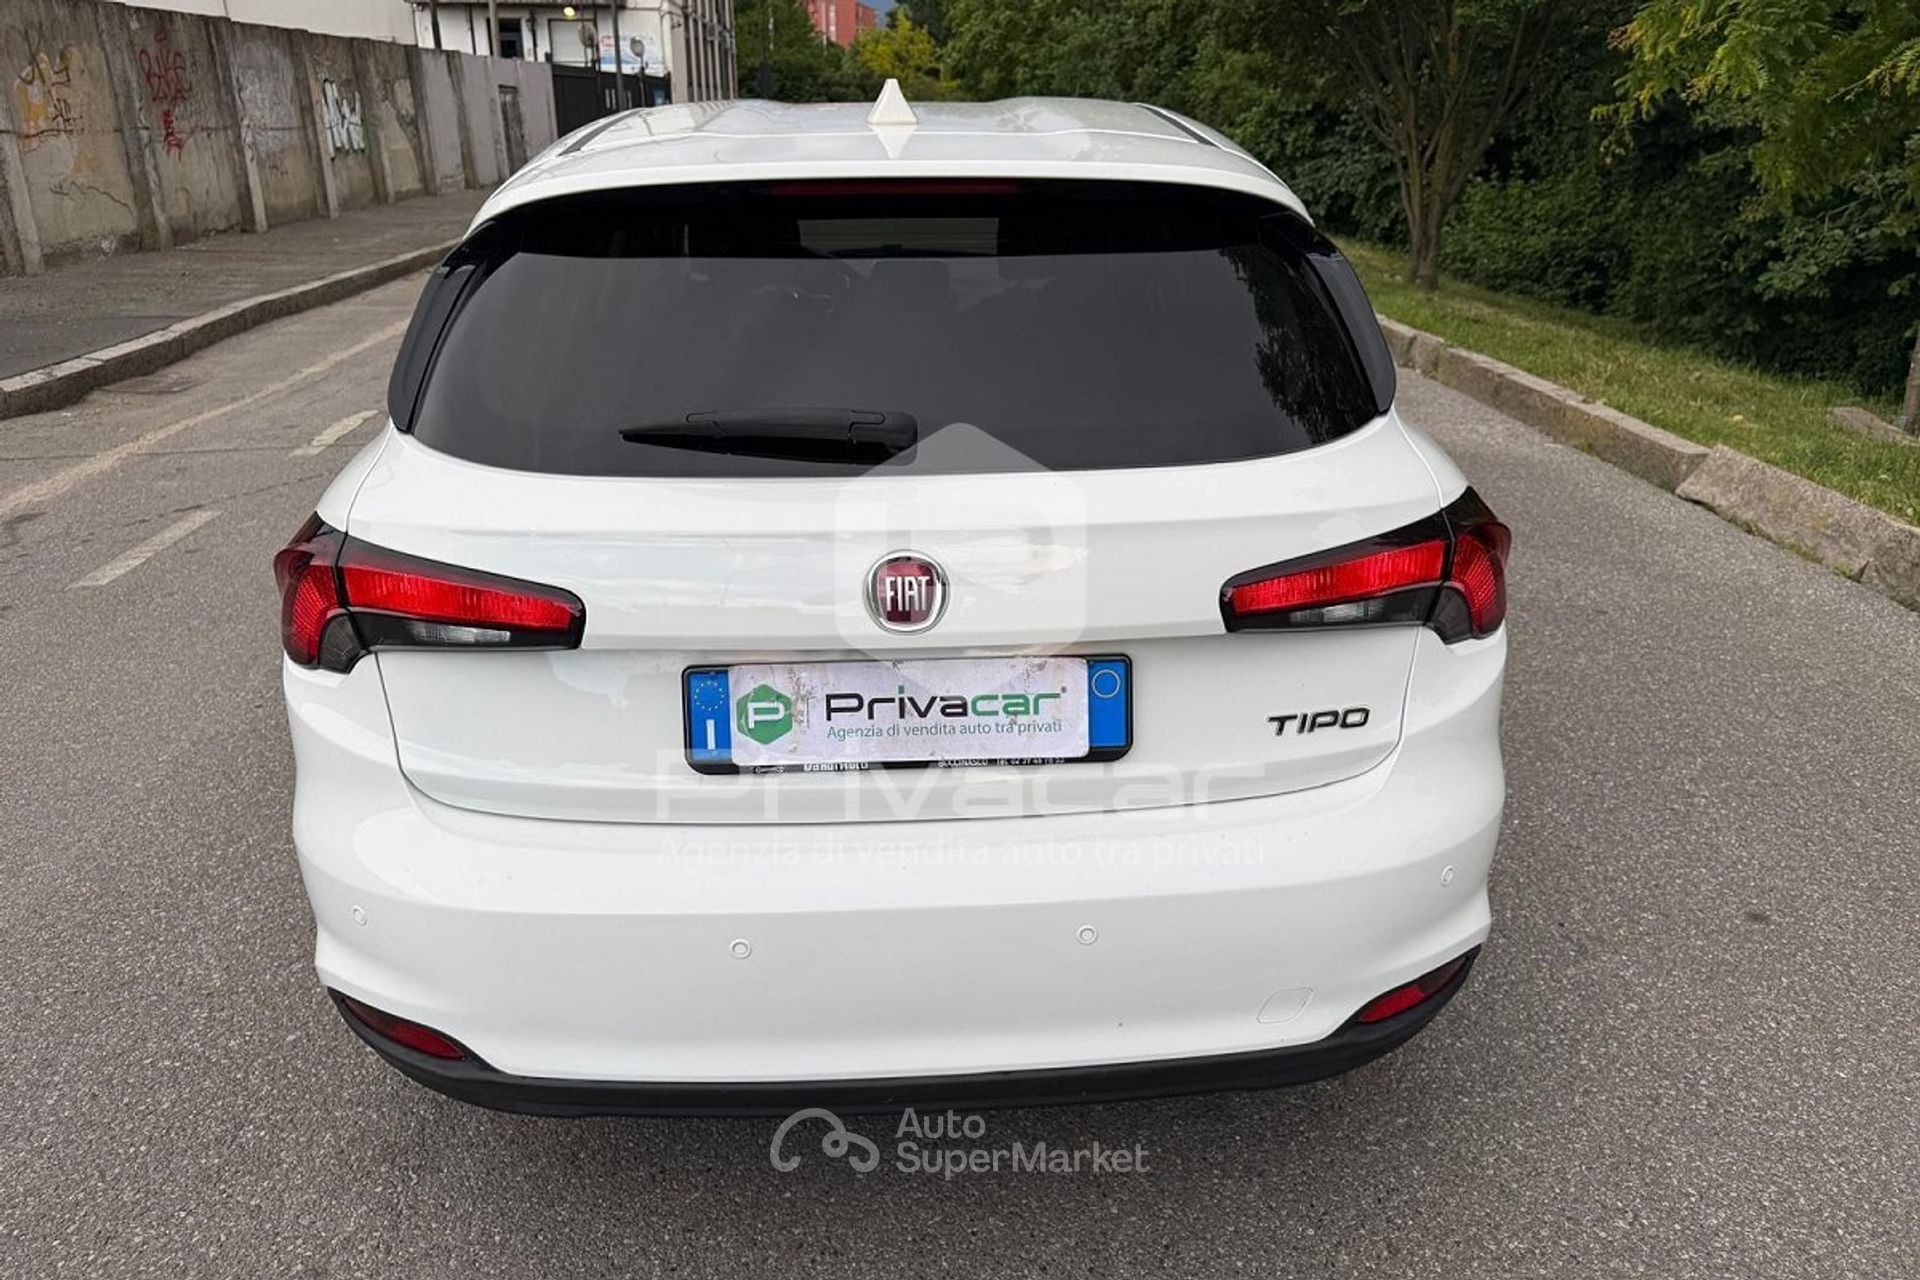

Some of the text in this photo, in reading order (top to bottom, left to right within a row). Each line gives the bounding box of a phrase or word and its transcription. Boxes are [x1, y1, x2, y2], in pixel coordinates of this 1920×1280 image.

[885, 576, 930, 611] FIAT
[827, 719, 1062, 741] Agenzia di vendita auto tra privati
[1268, 707, 1371, 736] TIPO
